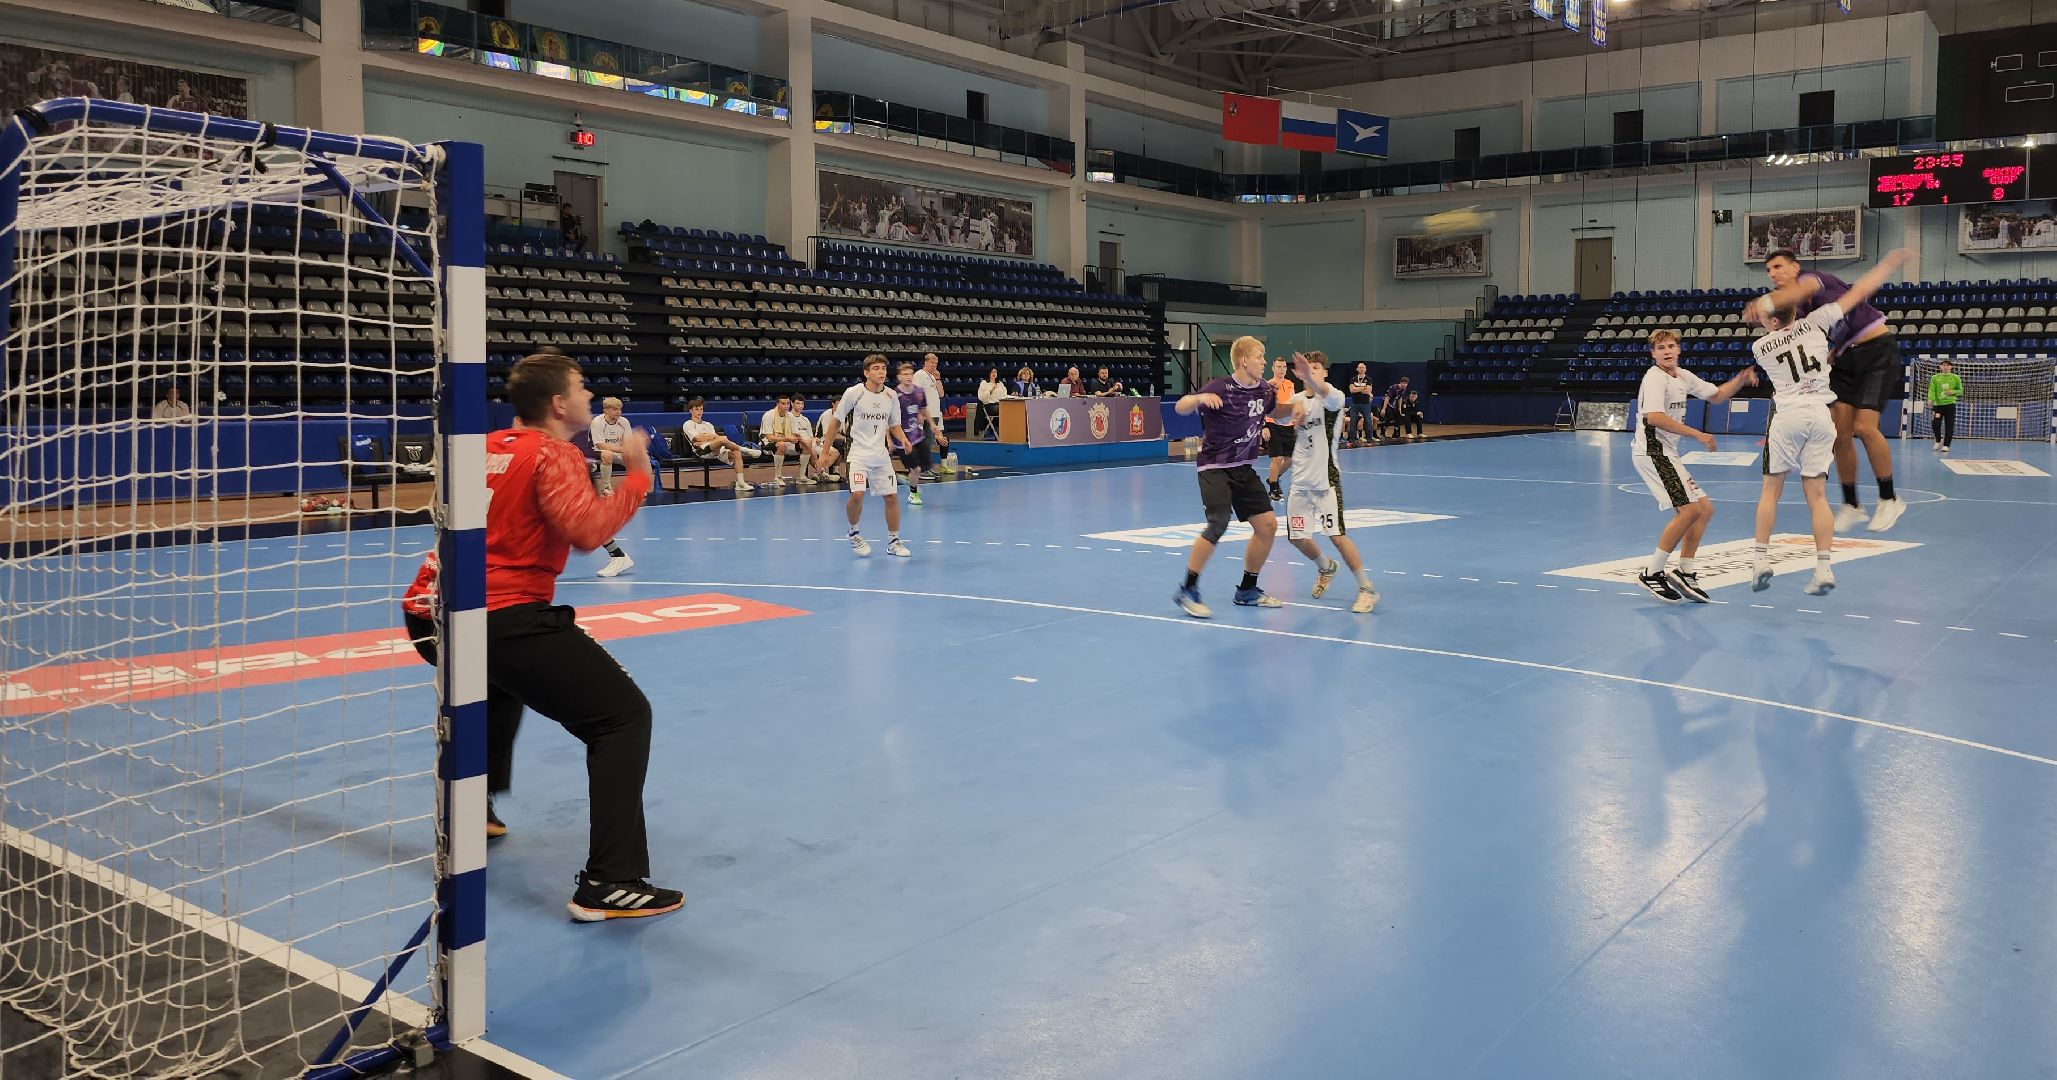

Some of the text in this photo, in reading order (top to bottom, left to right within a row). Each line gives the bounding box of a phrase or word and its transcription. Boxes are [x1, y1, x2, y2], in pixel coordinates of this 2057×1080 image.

[1893, 192, 1915, 206] 17
[1776, 344, 1821, 383] 74
[1248, 399, 1264, 417] 28
[888, 475, 894, 487] 7
